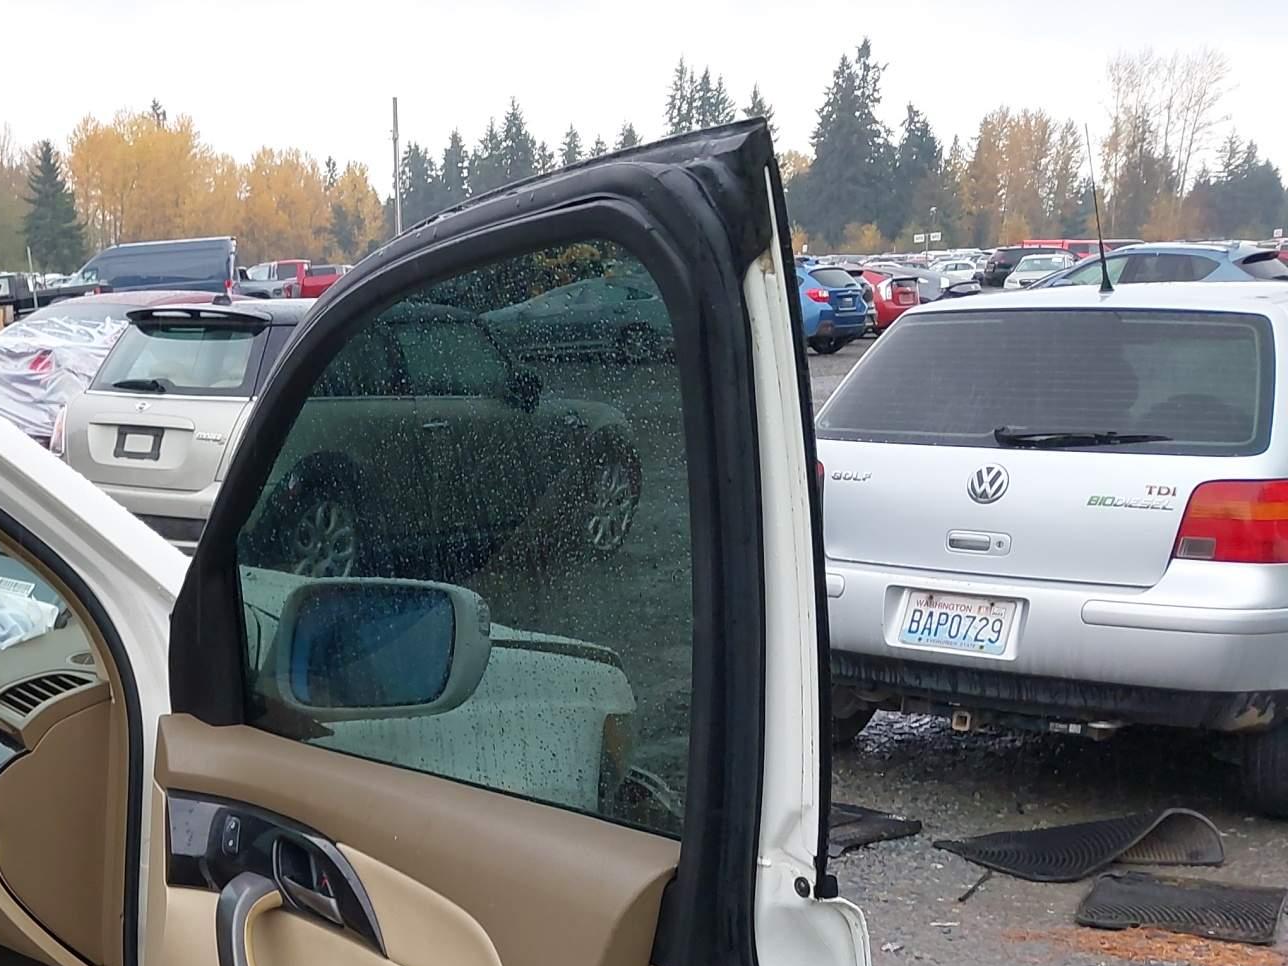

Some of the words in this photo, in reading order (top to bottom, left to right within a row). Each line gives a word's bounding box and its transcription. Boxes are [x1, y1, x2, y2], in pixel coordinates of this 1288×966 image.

[831, 471, 873, 482] GOLF
[1145, 484, 1177, 497] TDI
[1087, 495, 1174, 511] BIODIESEL
[908, 609, 1004, 645] BAP0729
